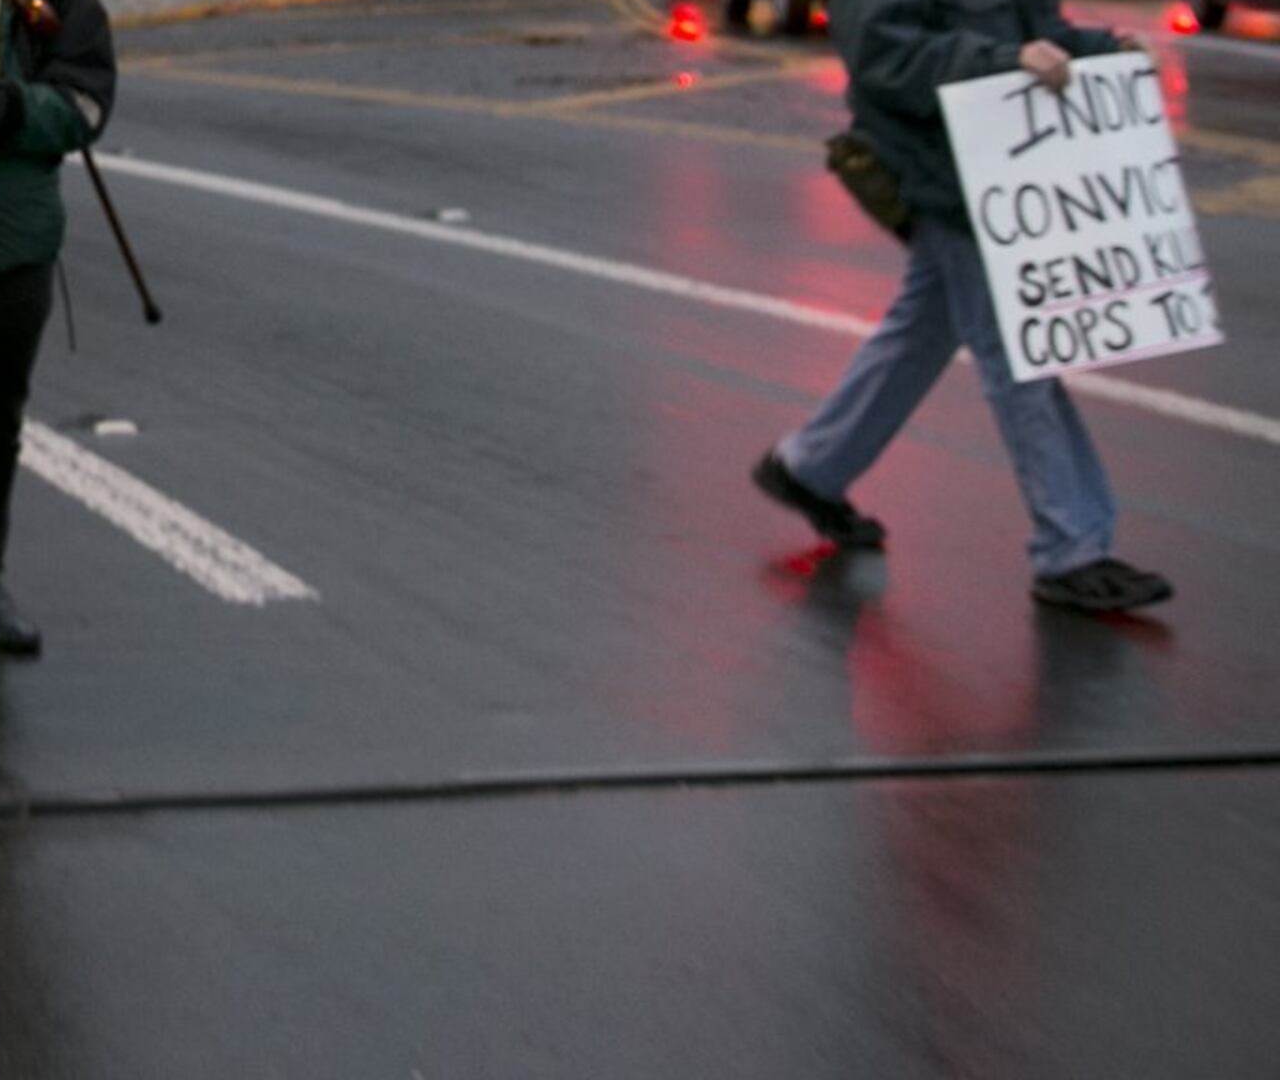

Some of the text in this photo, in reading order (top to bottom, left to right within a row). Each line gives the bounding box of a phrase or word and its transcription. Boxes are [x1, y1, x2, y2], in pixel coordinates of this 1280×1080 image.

[1000, 68, 1161, 158] INDIC
[980, 156, 1181, 246] CONVIC
[1017, 231, 1207, 308] SEND KIL
[1019, 290, 1201, 367] COPS TO
